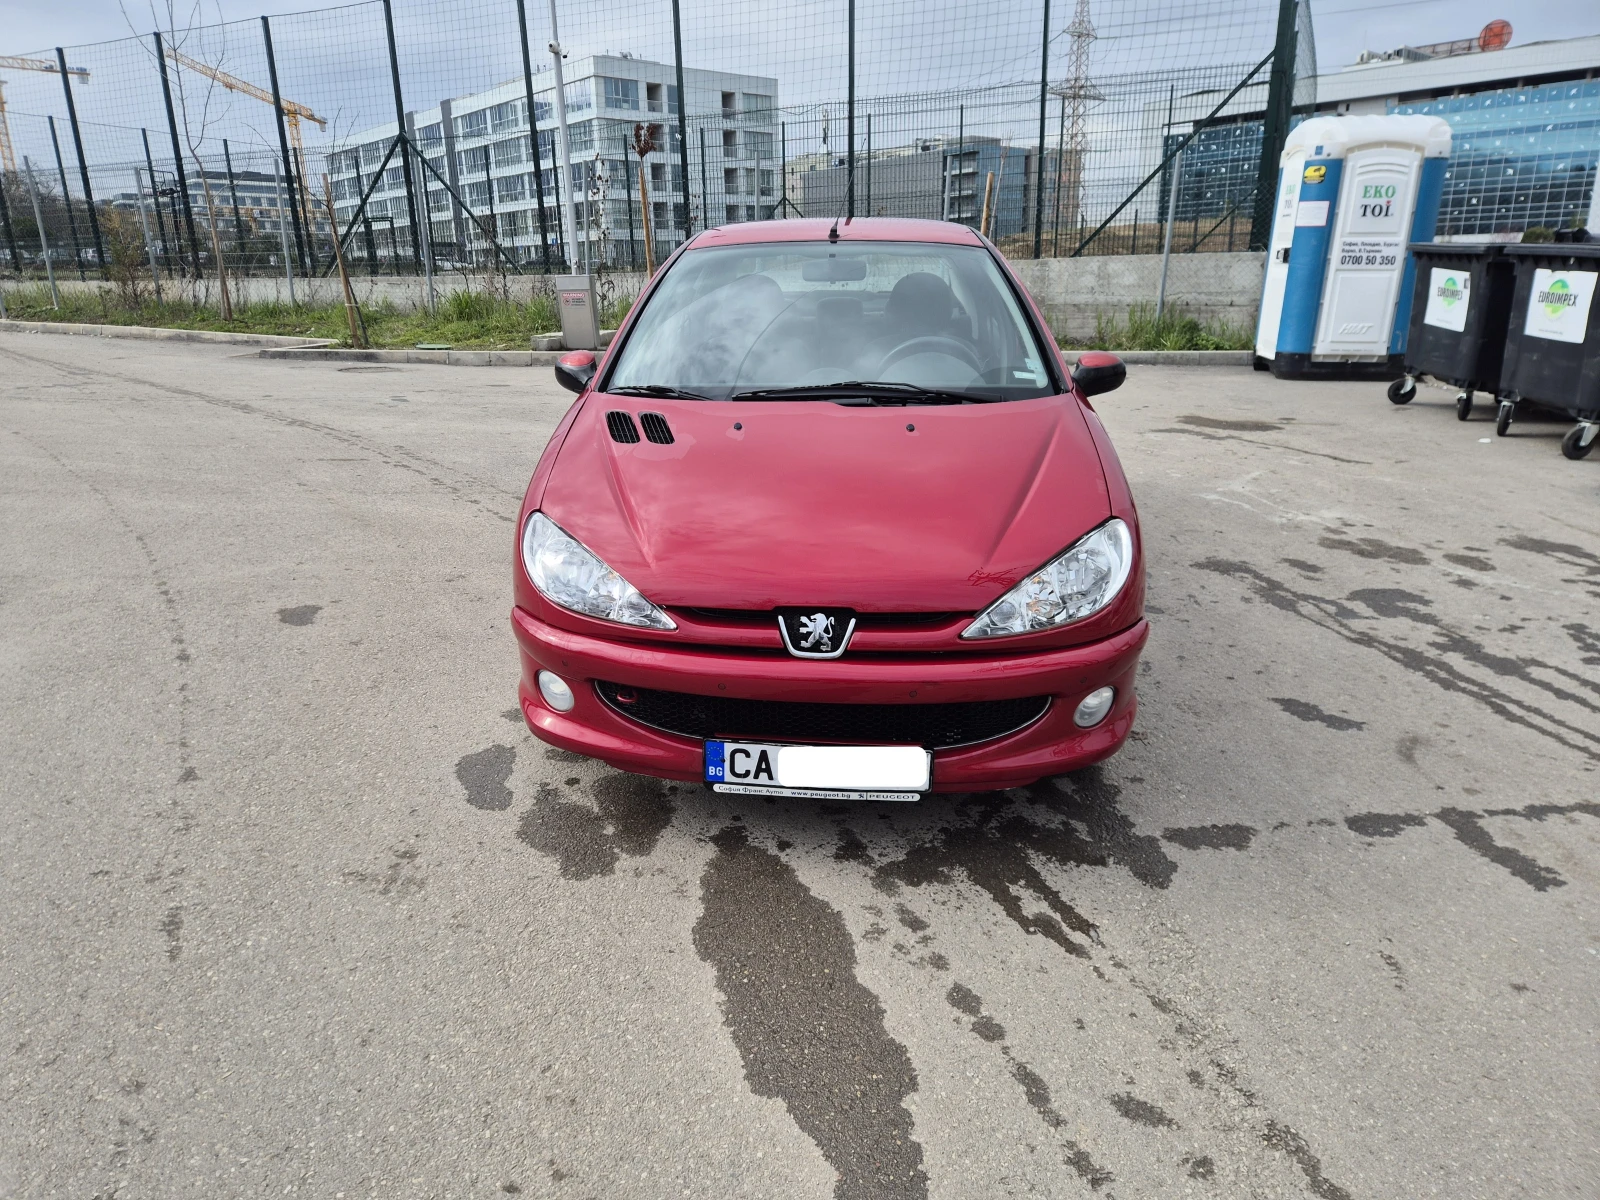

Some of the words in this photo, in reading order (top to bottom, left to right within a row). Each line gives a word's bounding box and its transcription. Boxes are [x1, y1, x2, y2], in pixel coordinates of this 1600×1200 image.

[1362, 185, 1396, 199] EKO
[1340, 255, 1363, 265] 0700
[1365, 255, 1377, 265] 50
[1379, 255, 1397, 265] 350
[1538, 290, 1579, 307] EUROIMPEX
[729, 747, 774, 780] CA
[708, 766, 723, 776] BG
[718, 785, 741, 793] София
[742, 786, 764, 794] Франс
[791, 790, 851, 799] www.peugeot.bg
